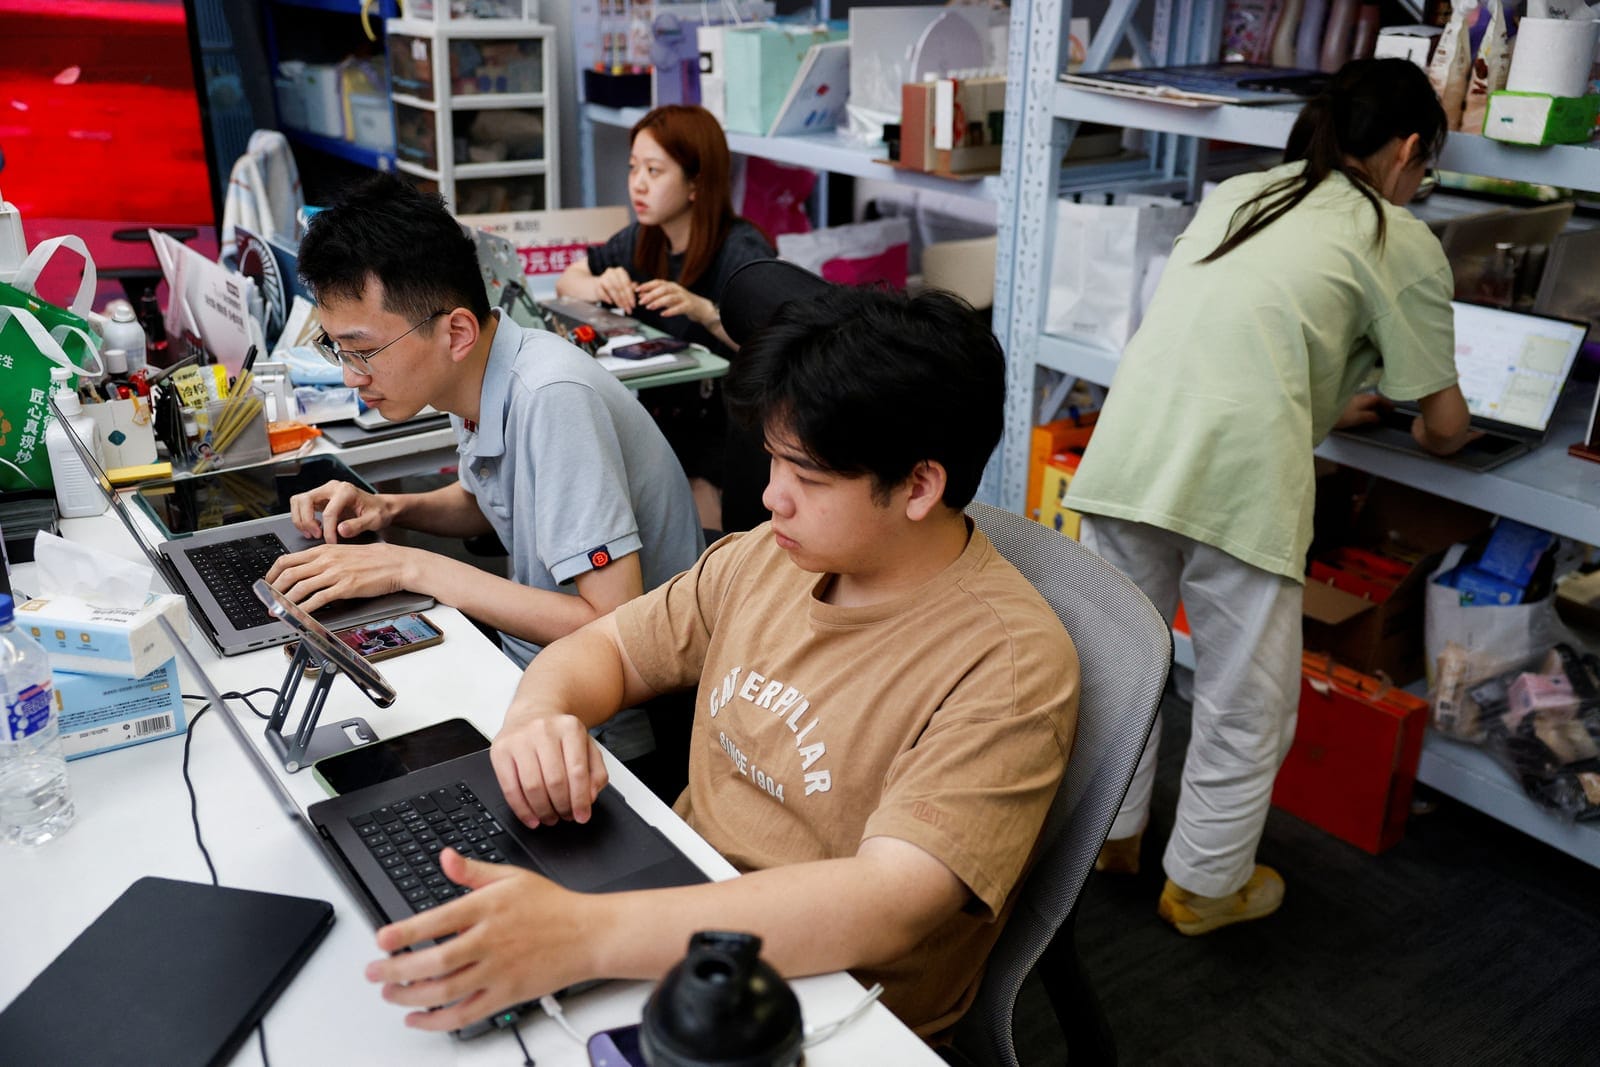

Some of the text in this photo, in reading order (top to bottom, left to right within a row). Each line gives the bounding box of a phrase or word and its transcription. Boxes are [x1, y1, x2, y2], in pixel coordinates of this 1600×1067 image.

[14, 387, 45, 464] 匠心真现炒
[709, 665, 832, 796] CATERPILLAR
[719, 731, 785, 804] SINCE 1904
